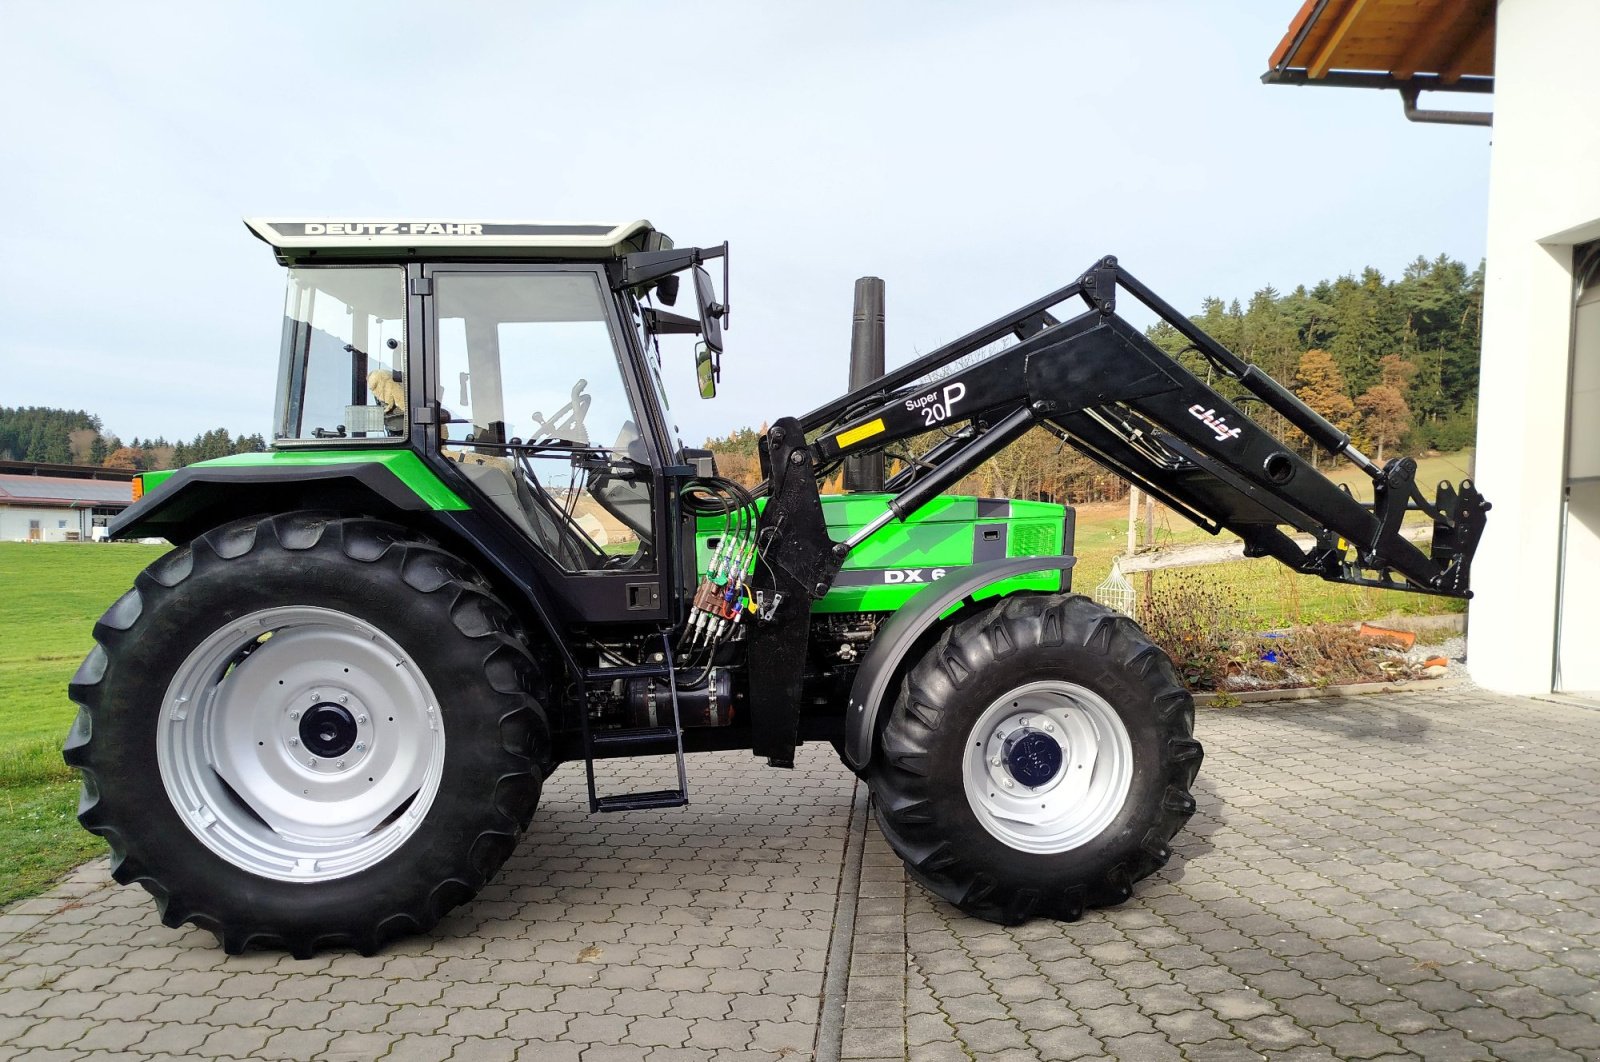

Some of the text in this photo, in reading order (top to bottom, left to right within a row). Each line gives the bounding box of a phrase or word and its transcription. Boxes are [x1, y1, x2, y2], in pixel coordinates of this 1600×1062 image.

[304, 223, 483, 236] DEUTZ-FAHR
[905, 391, 938, 411] Super
[1188, 404, 1242, 442] chief
[884, 569, 924, 584] DX
